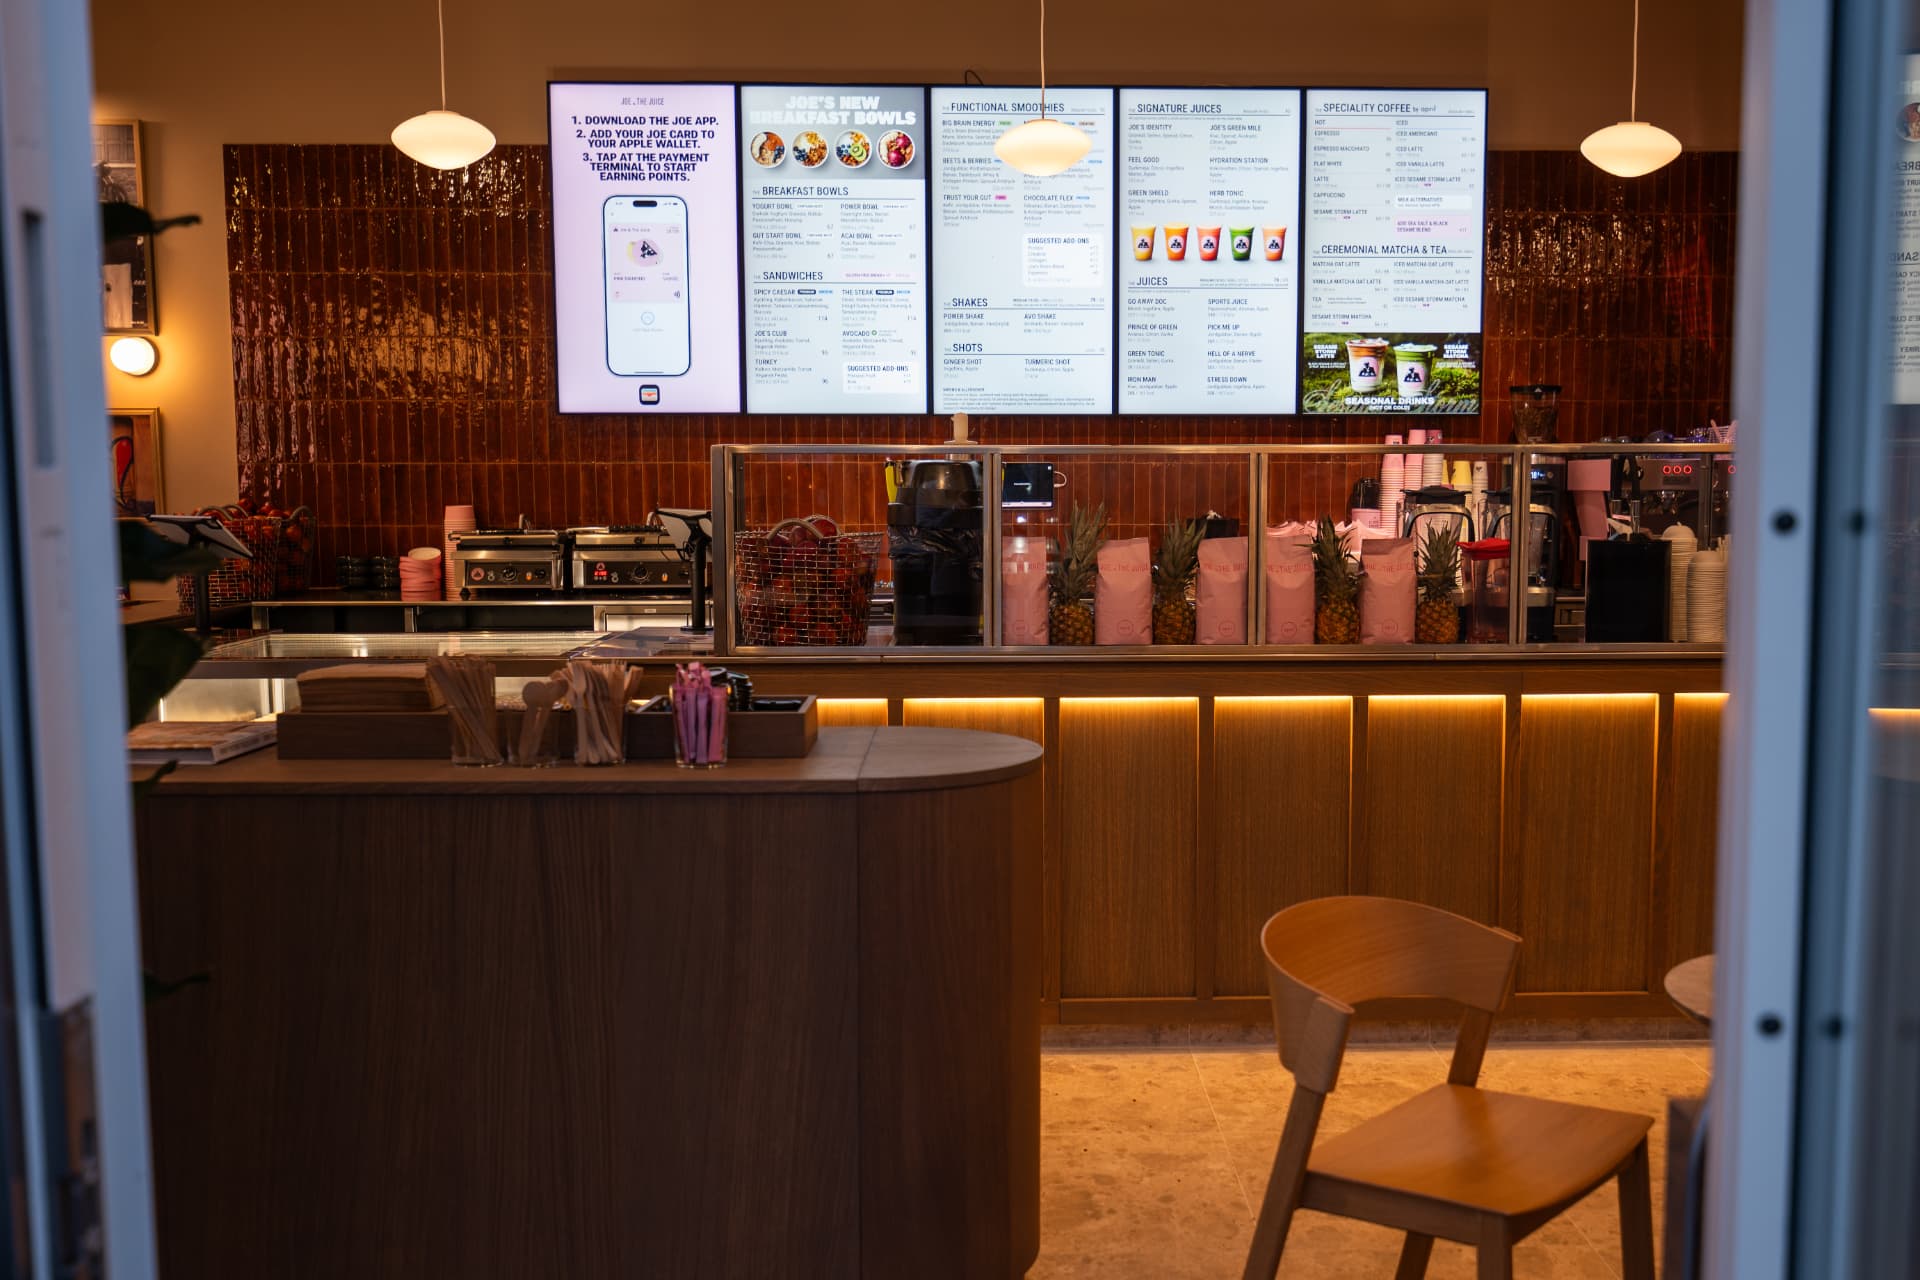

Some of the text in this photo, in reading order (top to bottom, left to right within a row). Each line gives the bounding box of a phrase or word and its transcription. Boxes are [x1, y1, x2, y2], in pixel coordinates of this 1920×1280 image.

[785, 96, 881, 110] JOE'S NEW
[951, 103, 1065, 112] FUNCTIONAL SMOOTHIES
[1137, 104, 1222, 113] SIGNATURE JUICES
[1323, 104, 1375, 113] SPECIALITY
[1377, 104, 1411, 113] COFFEE
[1421, 104, 1436, 113] april
[571, 116, 719, 126] 1. DOWNLOAD THE JOE APP.
[750, 111, 917, 125] BREAKFAST BOWLS
[576, 129, 714, 139] 2. ADD YOUR JOE CARD TO
[588, 139, 700, 149] YOUR APPLE WALLET.
[583, 153, 710, 162] 3. TAP AT THE PAYMENT
[590, 163, 696, 171] TERMINAL TO START
[600, 172, 690, 181] EARNING POINTS.
[762, 186, 849, 196] BREAKFAST BOWLS
[1321, 245, 1447, 254] CEREMONIAL MATCHA & TEA
[763, 272, 823, 280] SANDWICHES
[1137, 277, 1168, 286] JUICES
[952, 298, 988, 307] SHAKES
[953, 344, 983, 352] SHOTS
[1345, 396, 1435, 405] SEASONAL DRINKS
